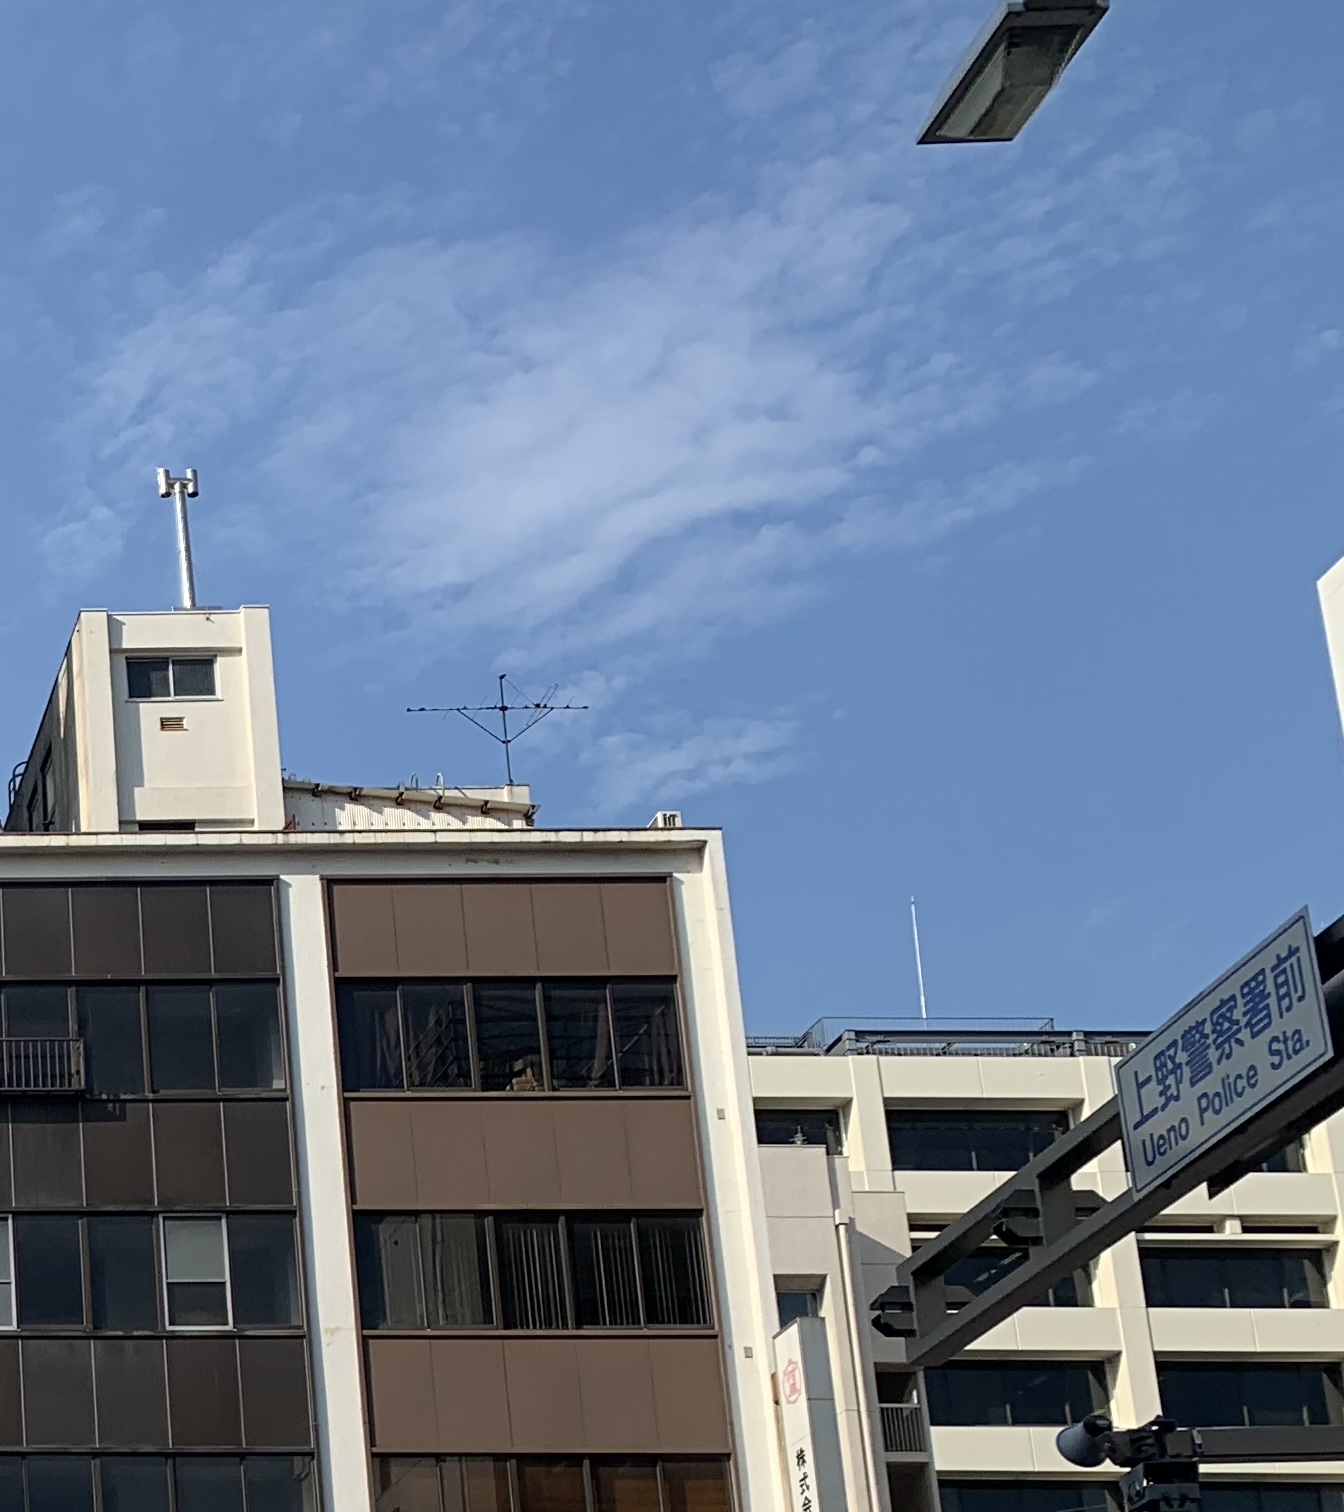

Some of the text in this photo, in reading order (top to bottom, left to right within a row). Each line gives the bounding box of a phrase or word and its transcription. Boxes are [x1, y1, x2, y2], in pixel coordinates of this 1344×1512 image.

[1133, 944, 1307, 1131] 上野警察署前
[1141, 1027, 1311, 1168] Ueno Police Sta.
